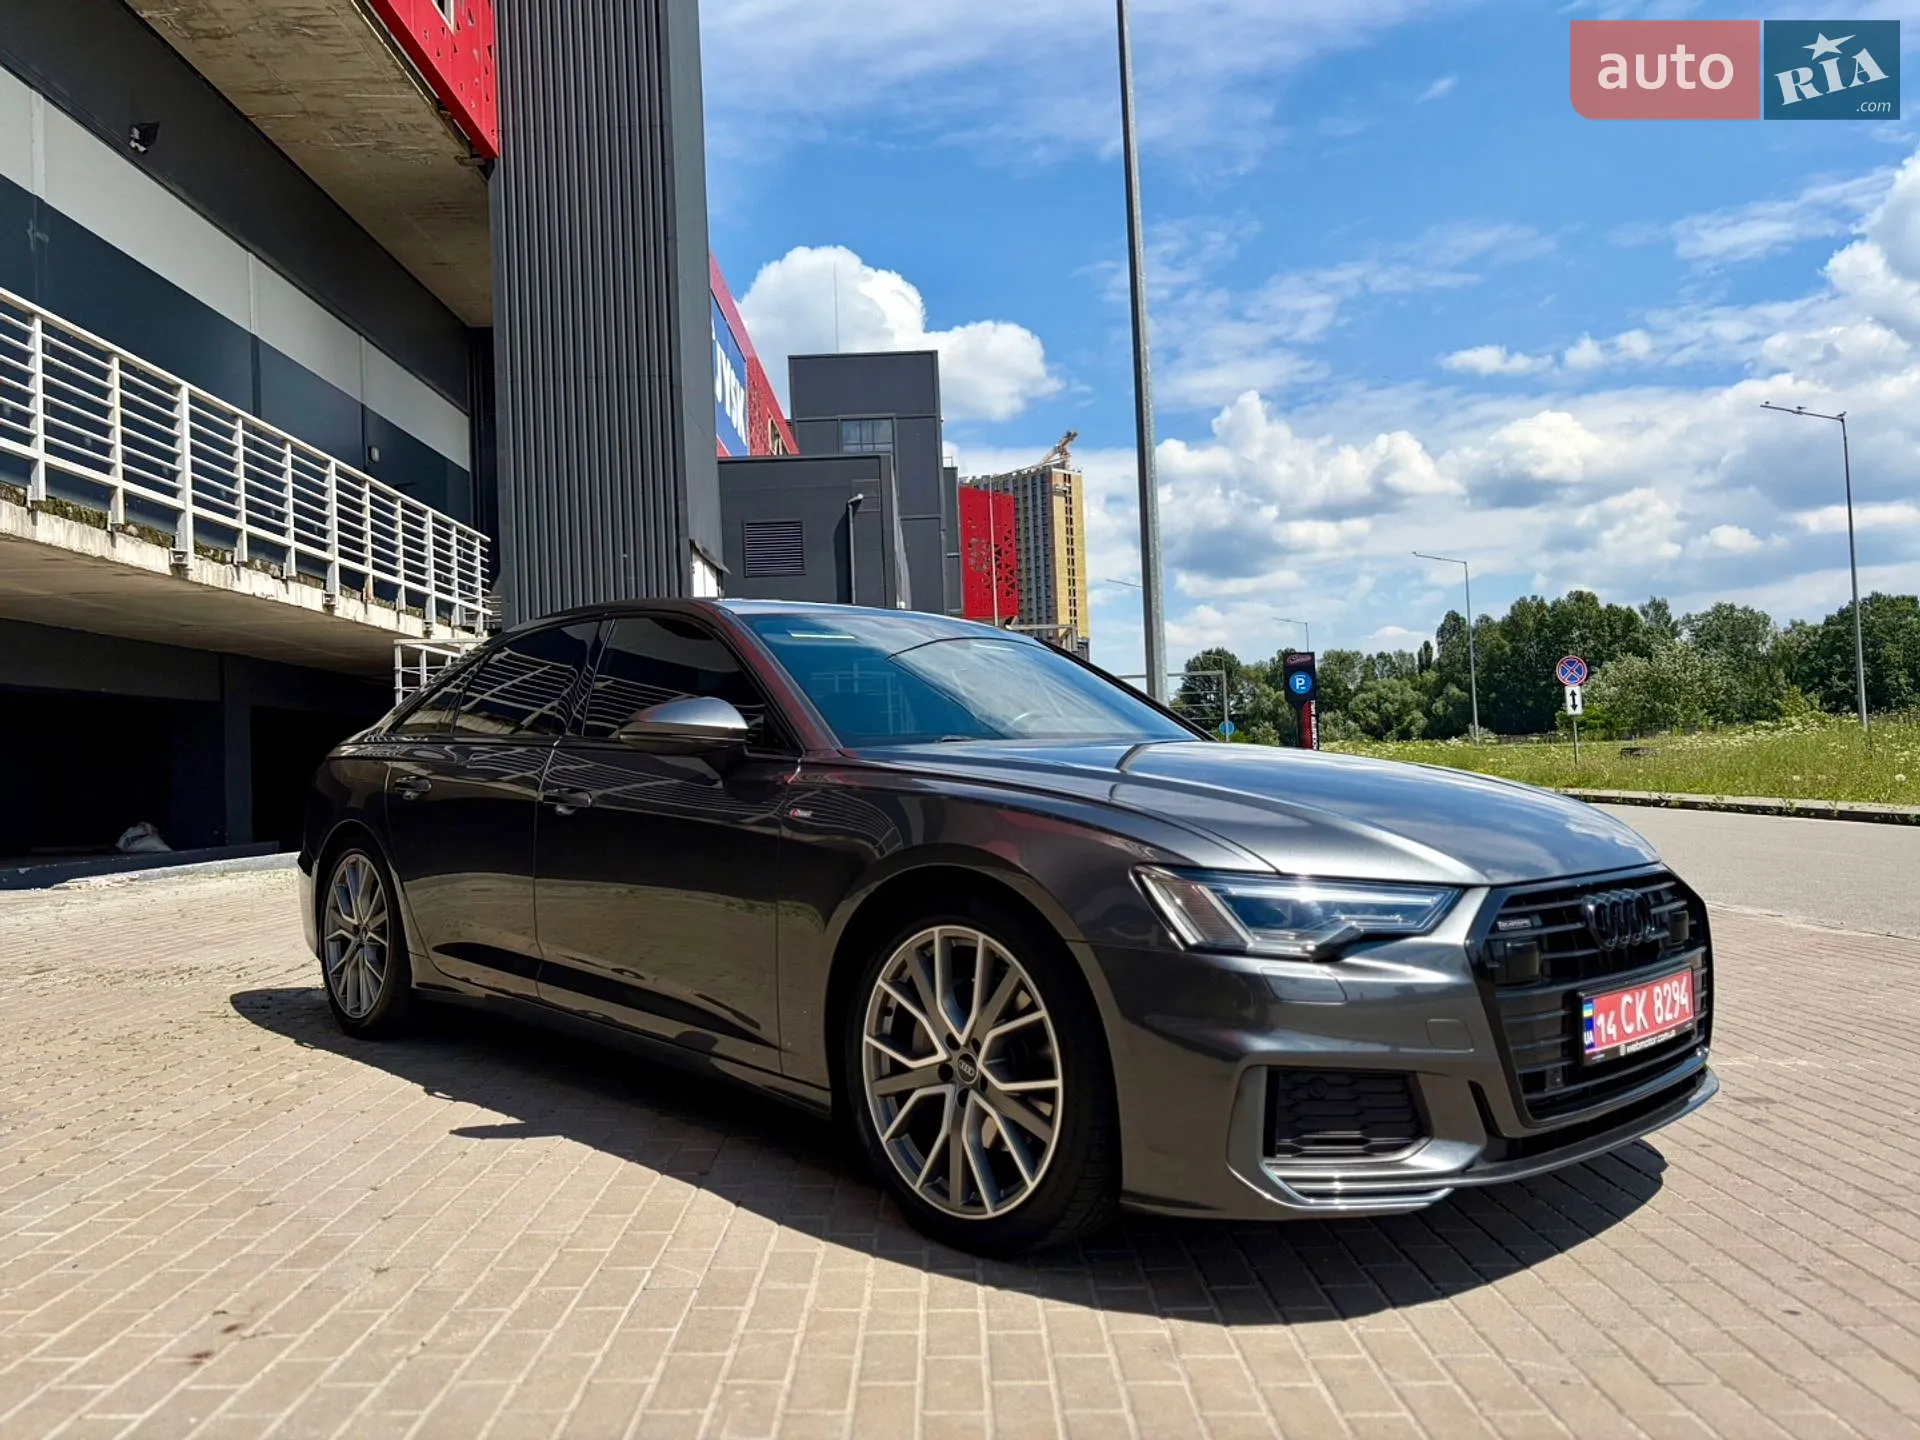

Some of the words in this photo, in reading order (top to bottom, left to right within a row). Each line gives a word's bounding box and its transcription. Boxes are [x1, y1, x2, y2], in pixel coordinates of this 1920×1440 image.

[715, 340, 747, 446] JYSK
[1583, 1030, 1594, 1045] UA
[1596, 1010, 1617, 1044] 14
[1621, 990, 1649, 1034] CK
[1653, 976, 1689, 1024] 8294
